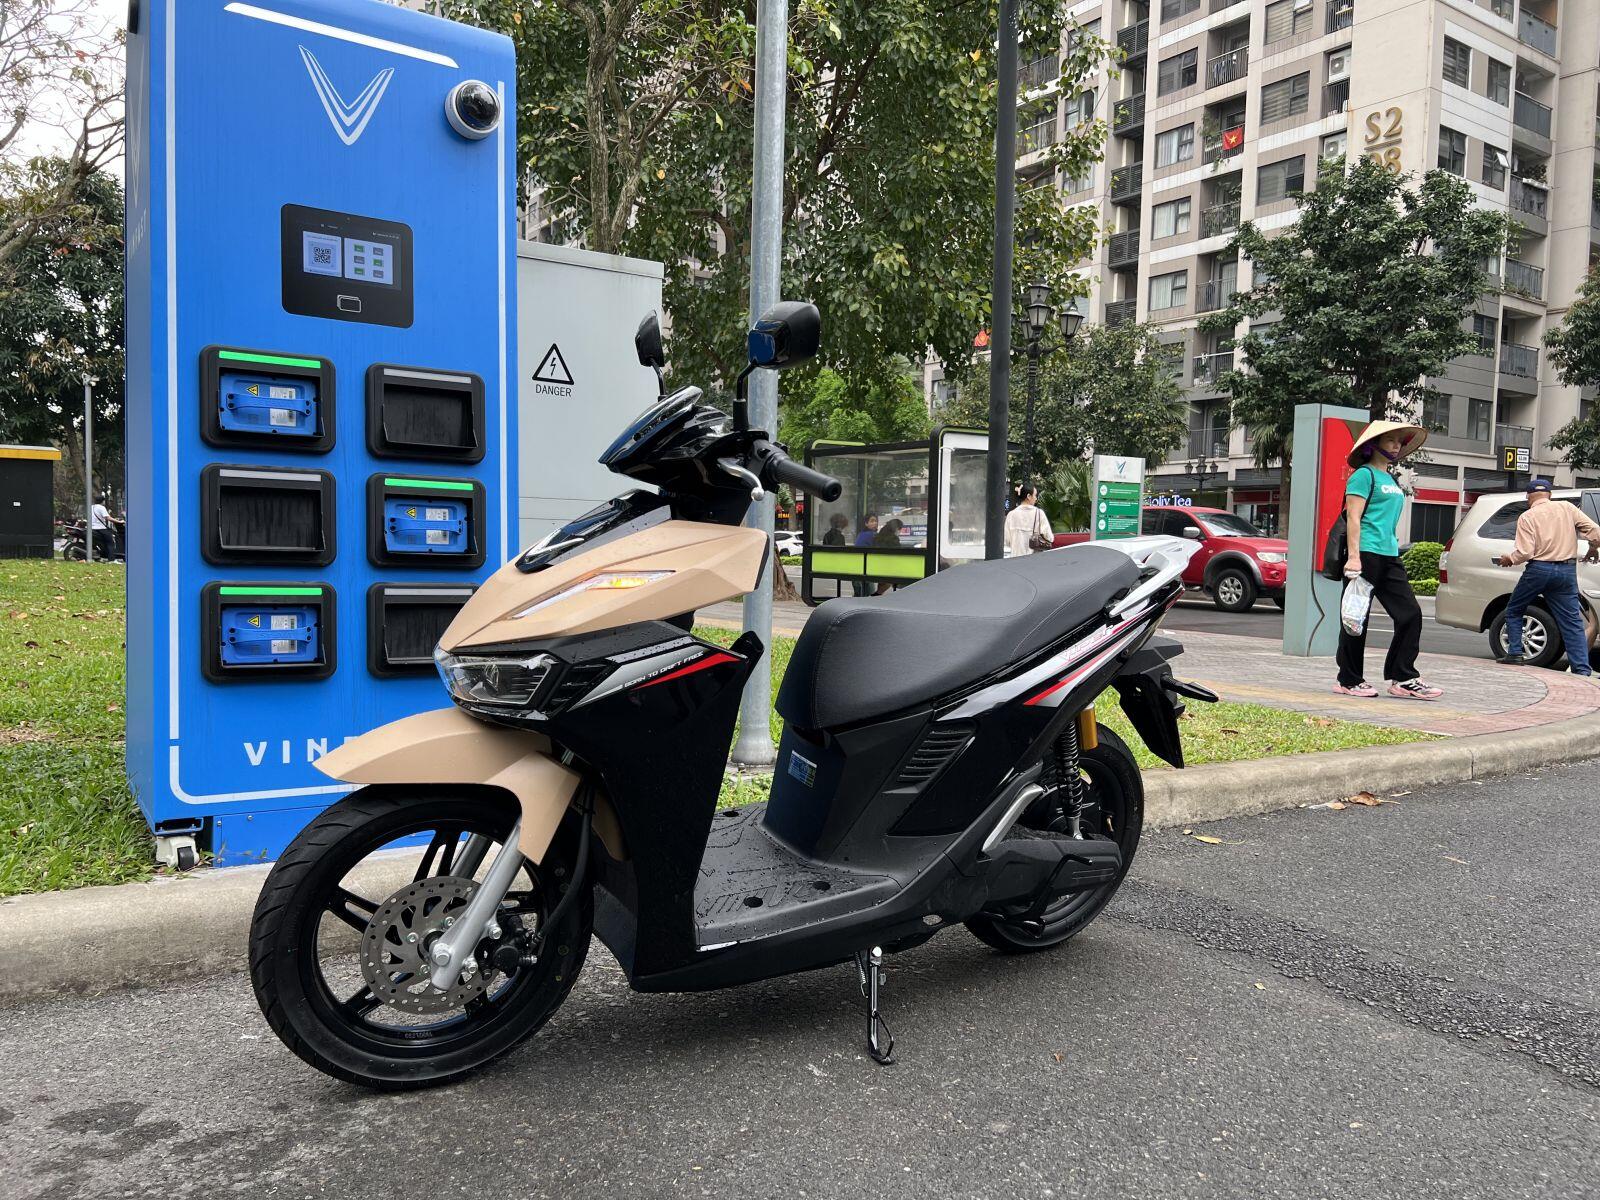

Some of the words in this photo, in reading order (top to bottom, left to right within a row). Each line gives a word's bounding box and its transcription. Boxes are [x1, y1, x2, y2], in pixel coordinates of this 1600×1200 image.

[1365, 107, 1402, 144] S2
[535, 384, 572, 397] DANGER
[1506, 452, 1514, 466] P
[1172, 494, 1192, 507] Tea
[625, 675, 646, 688] BORN
[648, 670, 659, 678] TO
[660, 660, 682, 674] DRIFT
[683, 651, 704, 664] FREE
[243, 736, 360, 766] VIN
